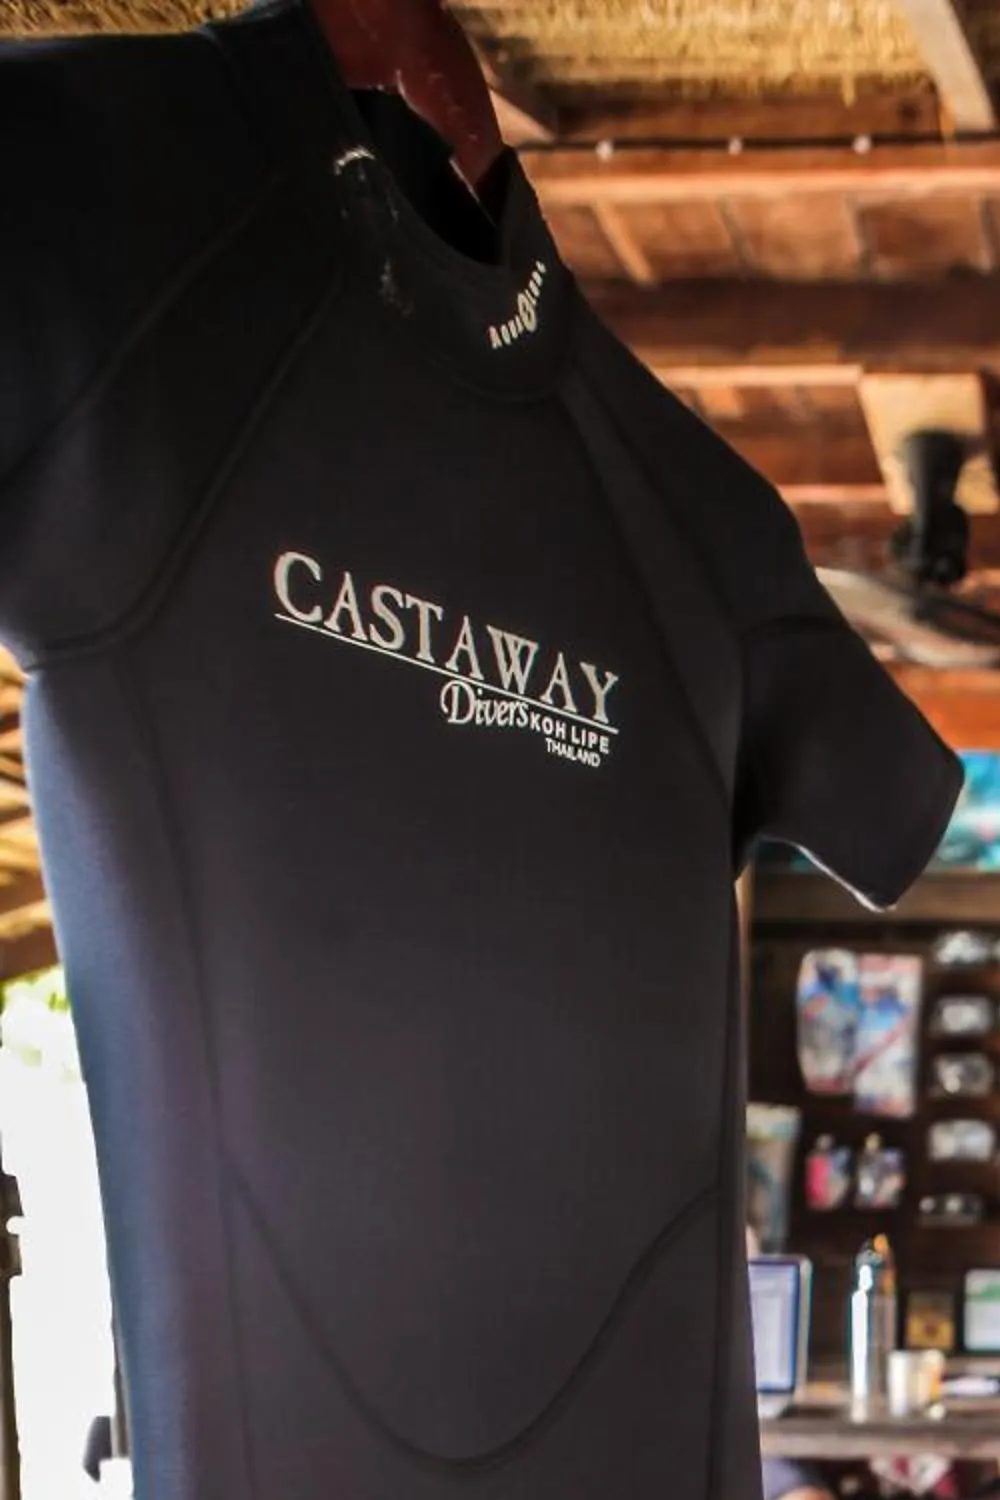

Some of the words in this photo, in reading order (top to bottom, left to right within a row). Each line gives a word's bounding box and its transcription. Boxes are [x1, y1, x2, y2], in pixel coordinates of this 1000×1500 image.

[273, 551, 620, 725] CASTAWAY
[440, 679, 530, 727] Divers
[530, 711, 566, 740] KOH
[571, 724, 610, 755] LIPE
[545, 737, 601, 768] THAILAND
